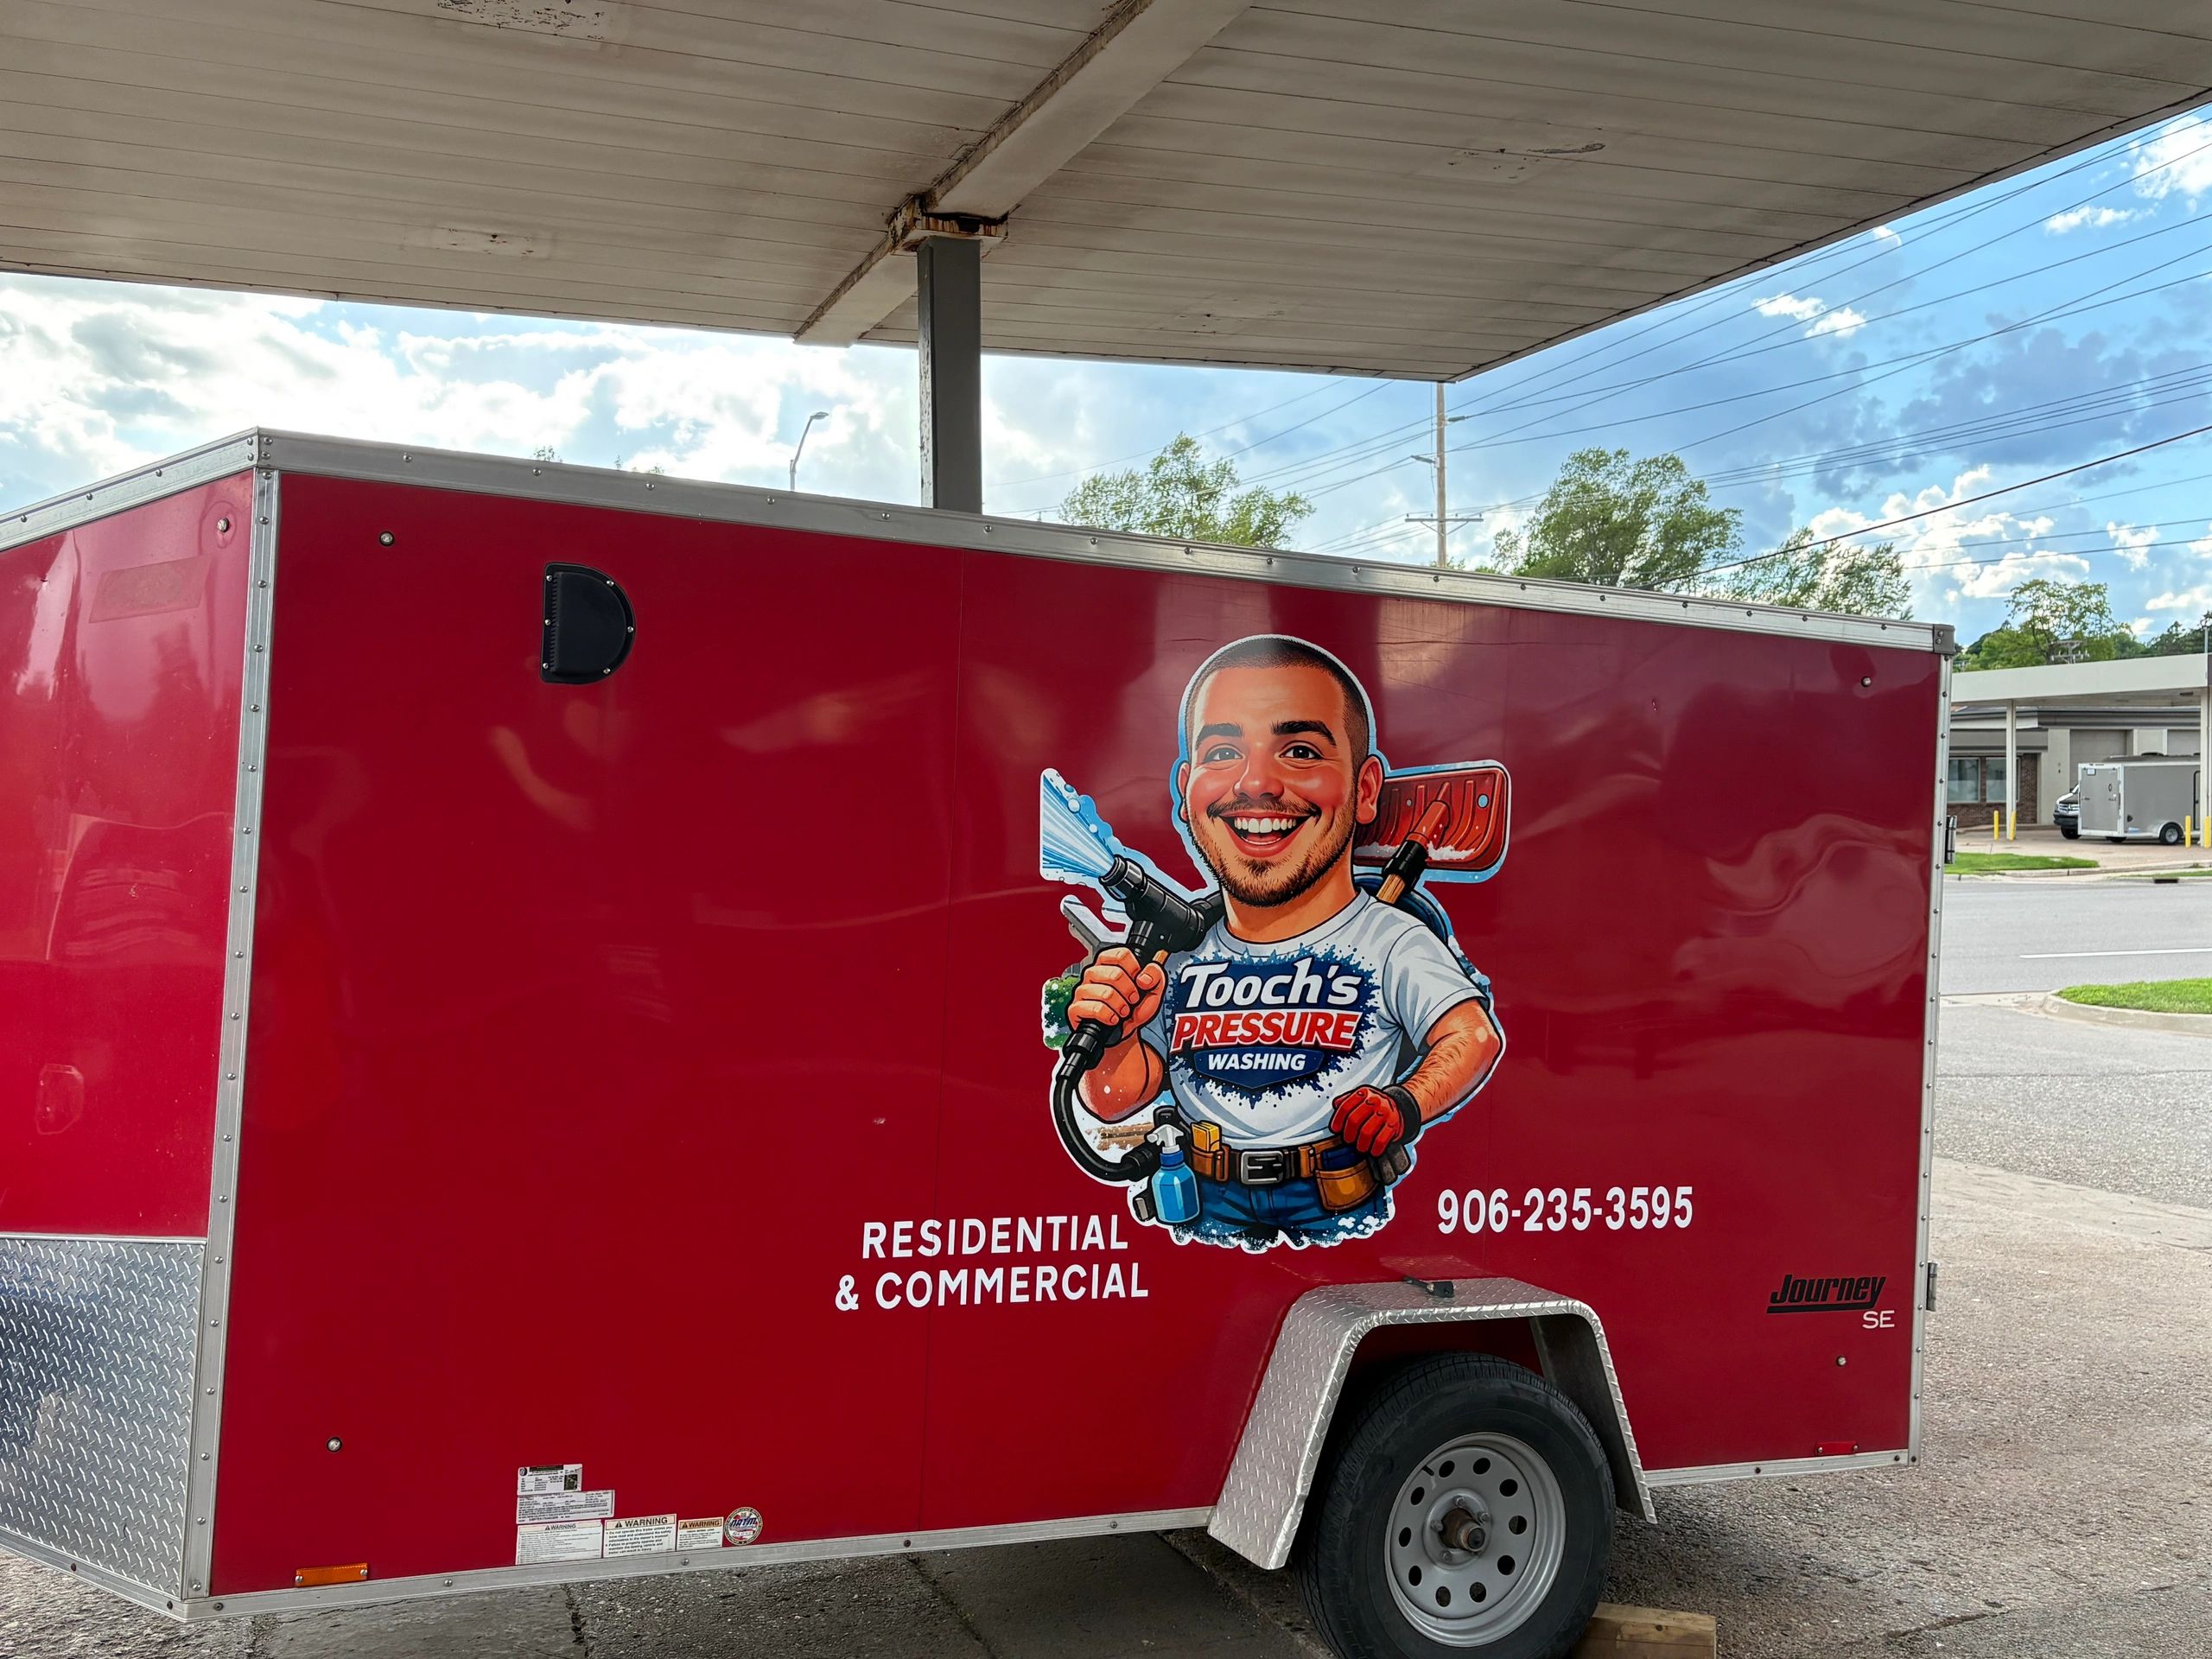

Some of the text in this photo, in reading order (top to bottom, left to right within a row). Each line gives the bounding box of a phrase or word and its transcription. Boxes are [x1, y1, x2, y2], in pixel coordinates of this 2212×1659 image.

[1180, 957, 1363, 1008] Tooch's
[1171, 1010, 1362, 1051] PRESSURE
[1208, 1053, 1306, 1071] WASHING
[1437, 1185, 1694, 1235] 906-235-3595
[862, 1214, 1128, 1260] RESIDENTIAL
[835, 1262, 1149, 1312] & COMMERCIAL
[1767, 1274, 1887, 1313] Journey
[1862, 1309, 1895, 1329] SE
[625, 1516, 668, 1528] WARNING
